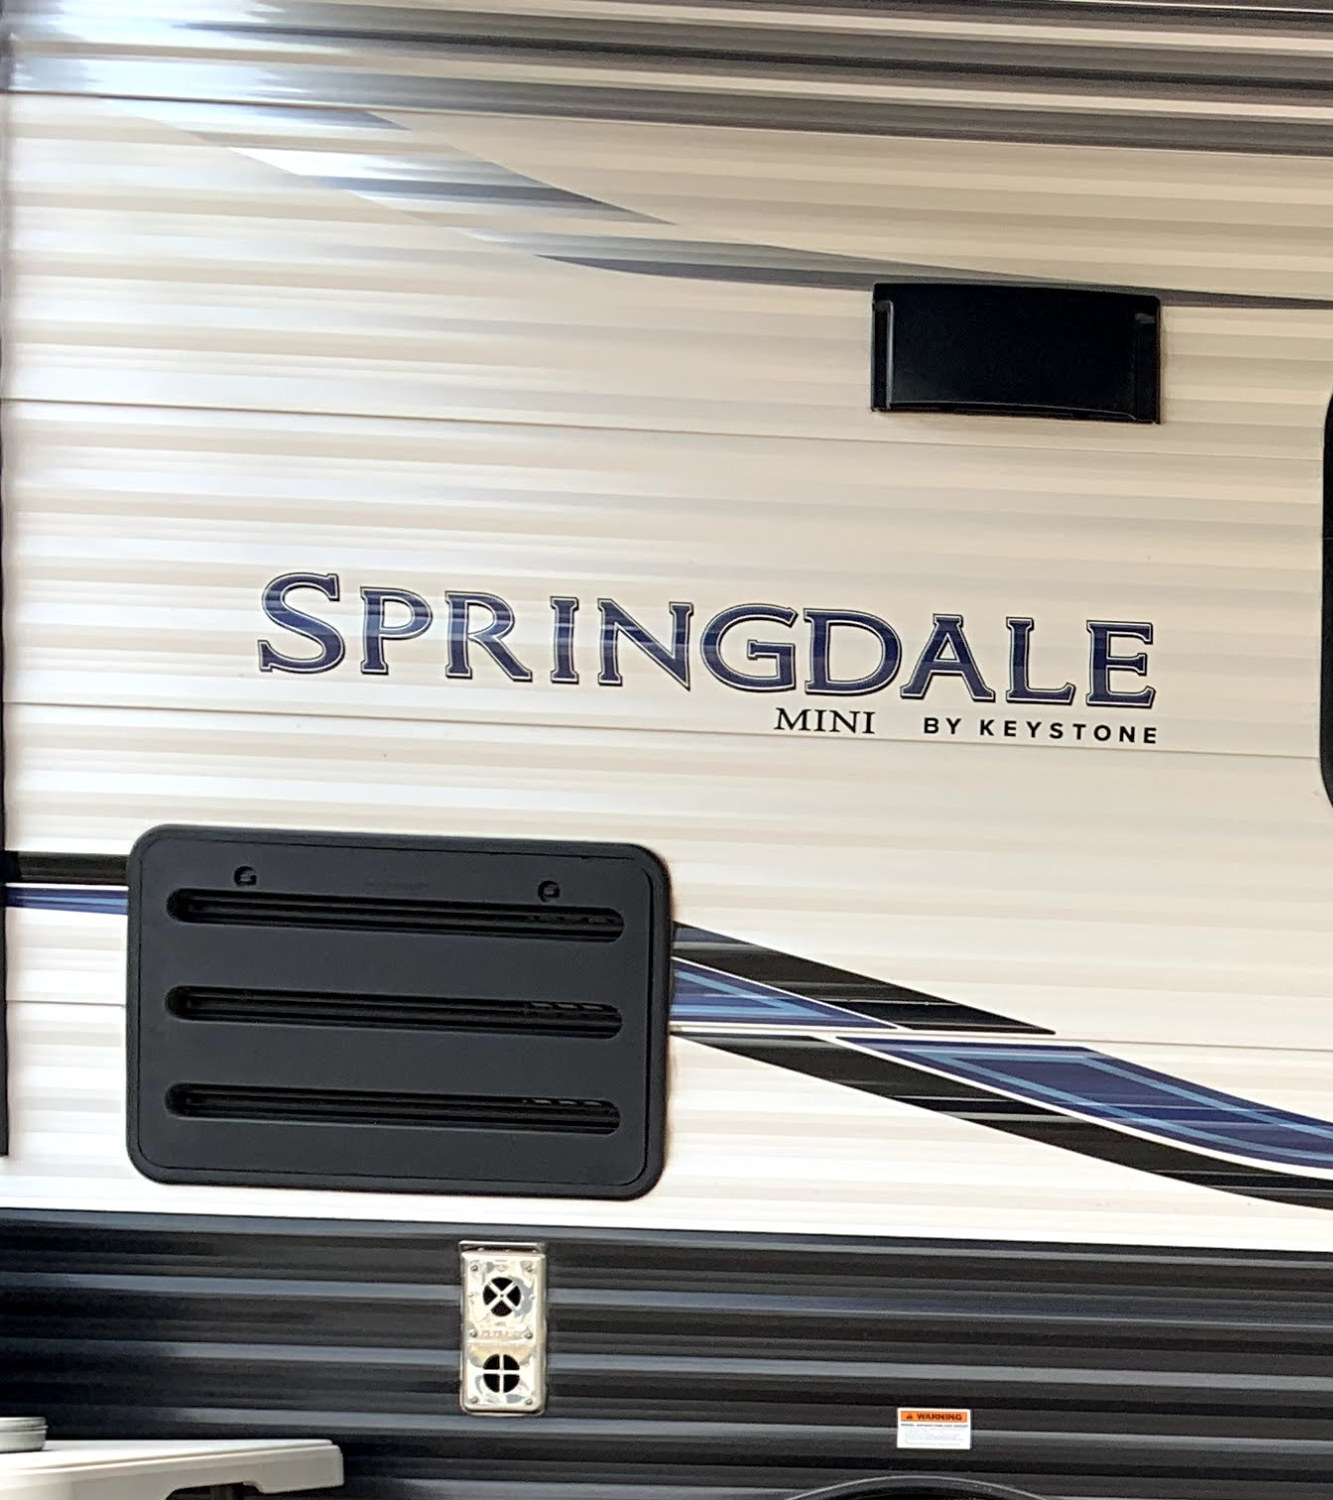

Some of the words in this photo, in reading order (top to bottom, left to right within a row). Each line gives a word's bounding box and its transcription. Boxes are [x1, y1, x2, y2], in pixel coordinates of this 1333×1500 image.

[257, 572, 1157, 708] SPRINGDALE
[774, 708, 876, 735] MINI
[923, 717, 961, 737] BY
[979, 720, 1159, 744] KEYSTONE
[917, 1413, 962, 1421] WARNING
